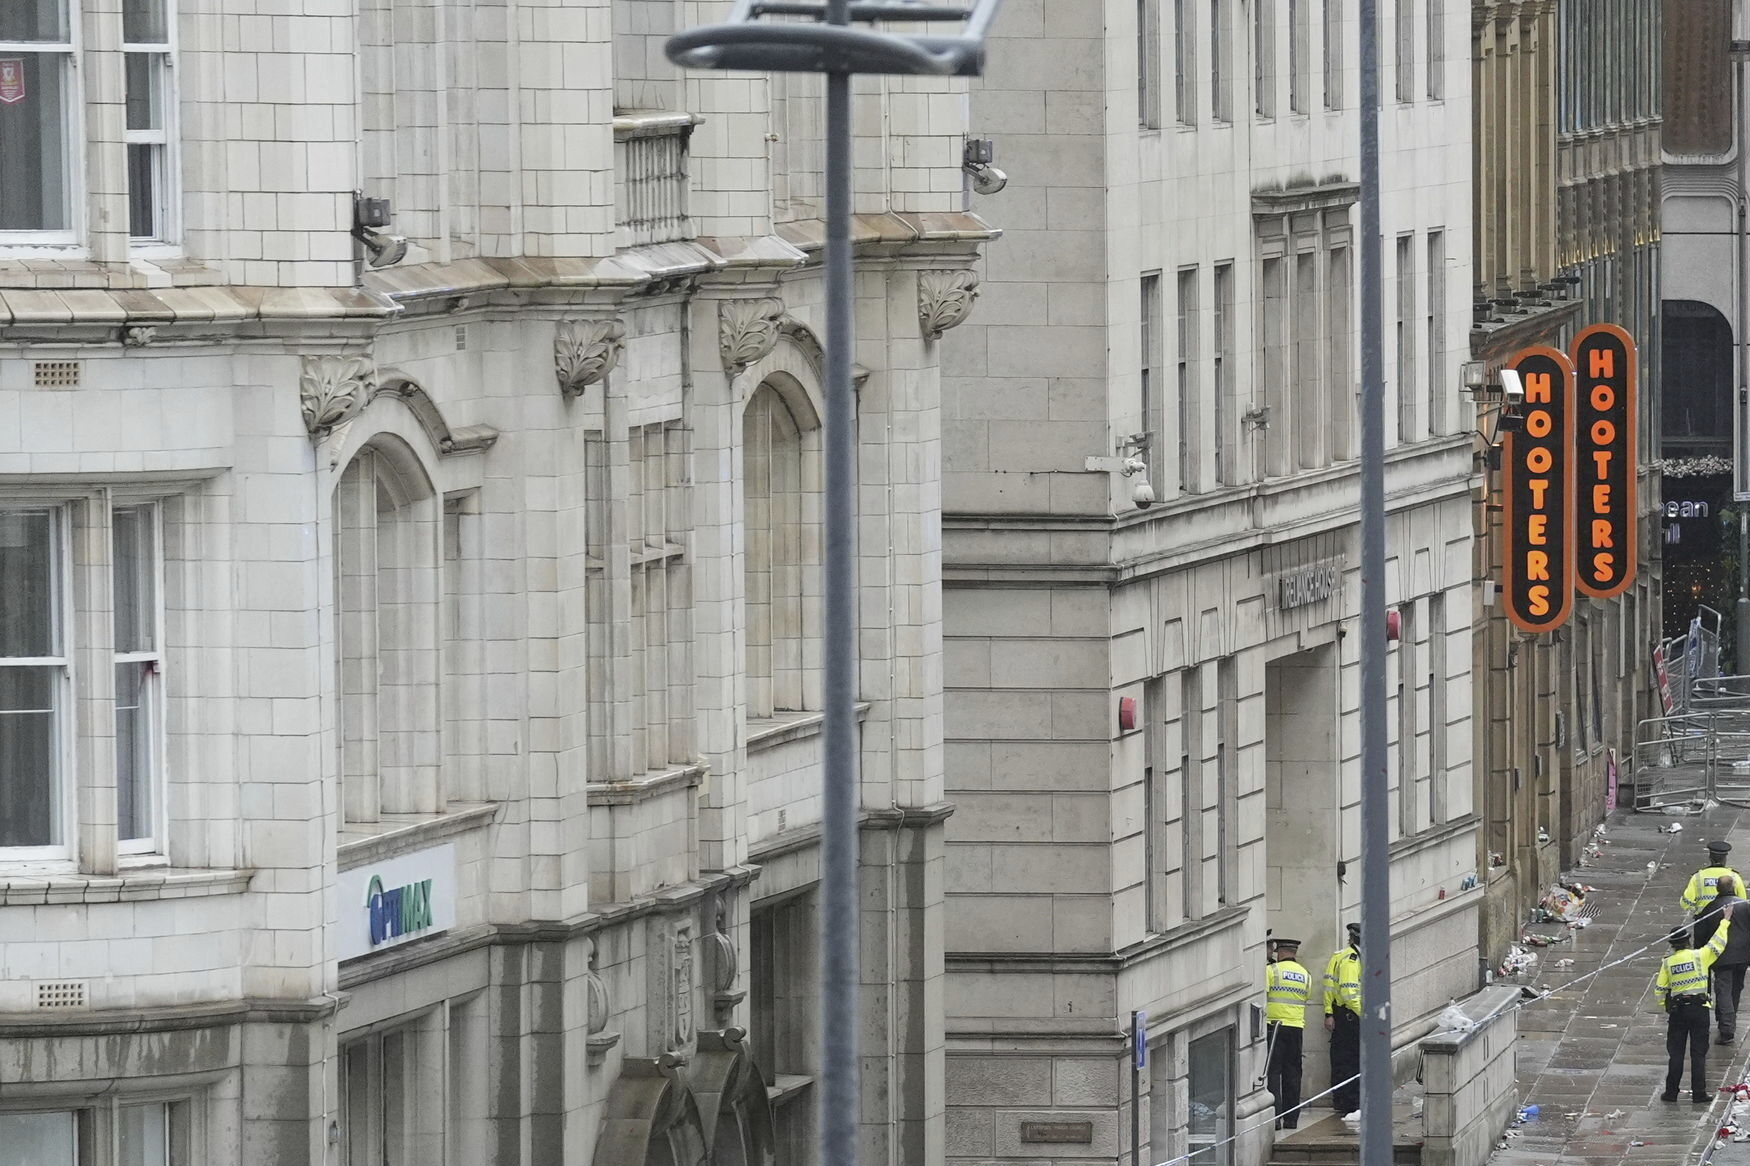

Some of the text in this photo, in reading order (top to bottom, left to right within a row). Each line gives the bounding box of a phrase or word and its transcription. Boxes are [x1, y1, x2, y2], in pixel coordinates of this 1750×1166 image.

[1589, 349, 1616, 582] HOOTERS
[1526, 372, 1552, 616] HOOTERS
[1705, 878, 1718, 887] POL
[1671, 962, 1694, 974] POLICE
[1283, 972, 1305, 983] POLICE
